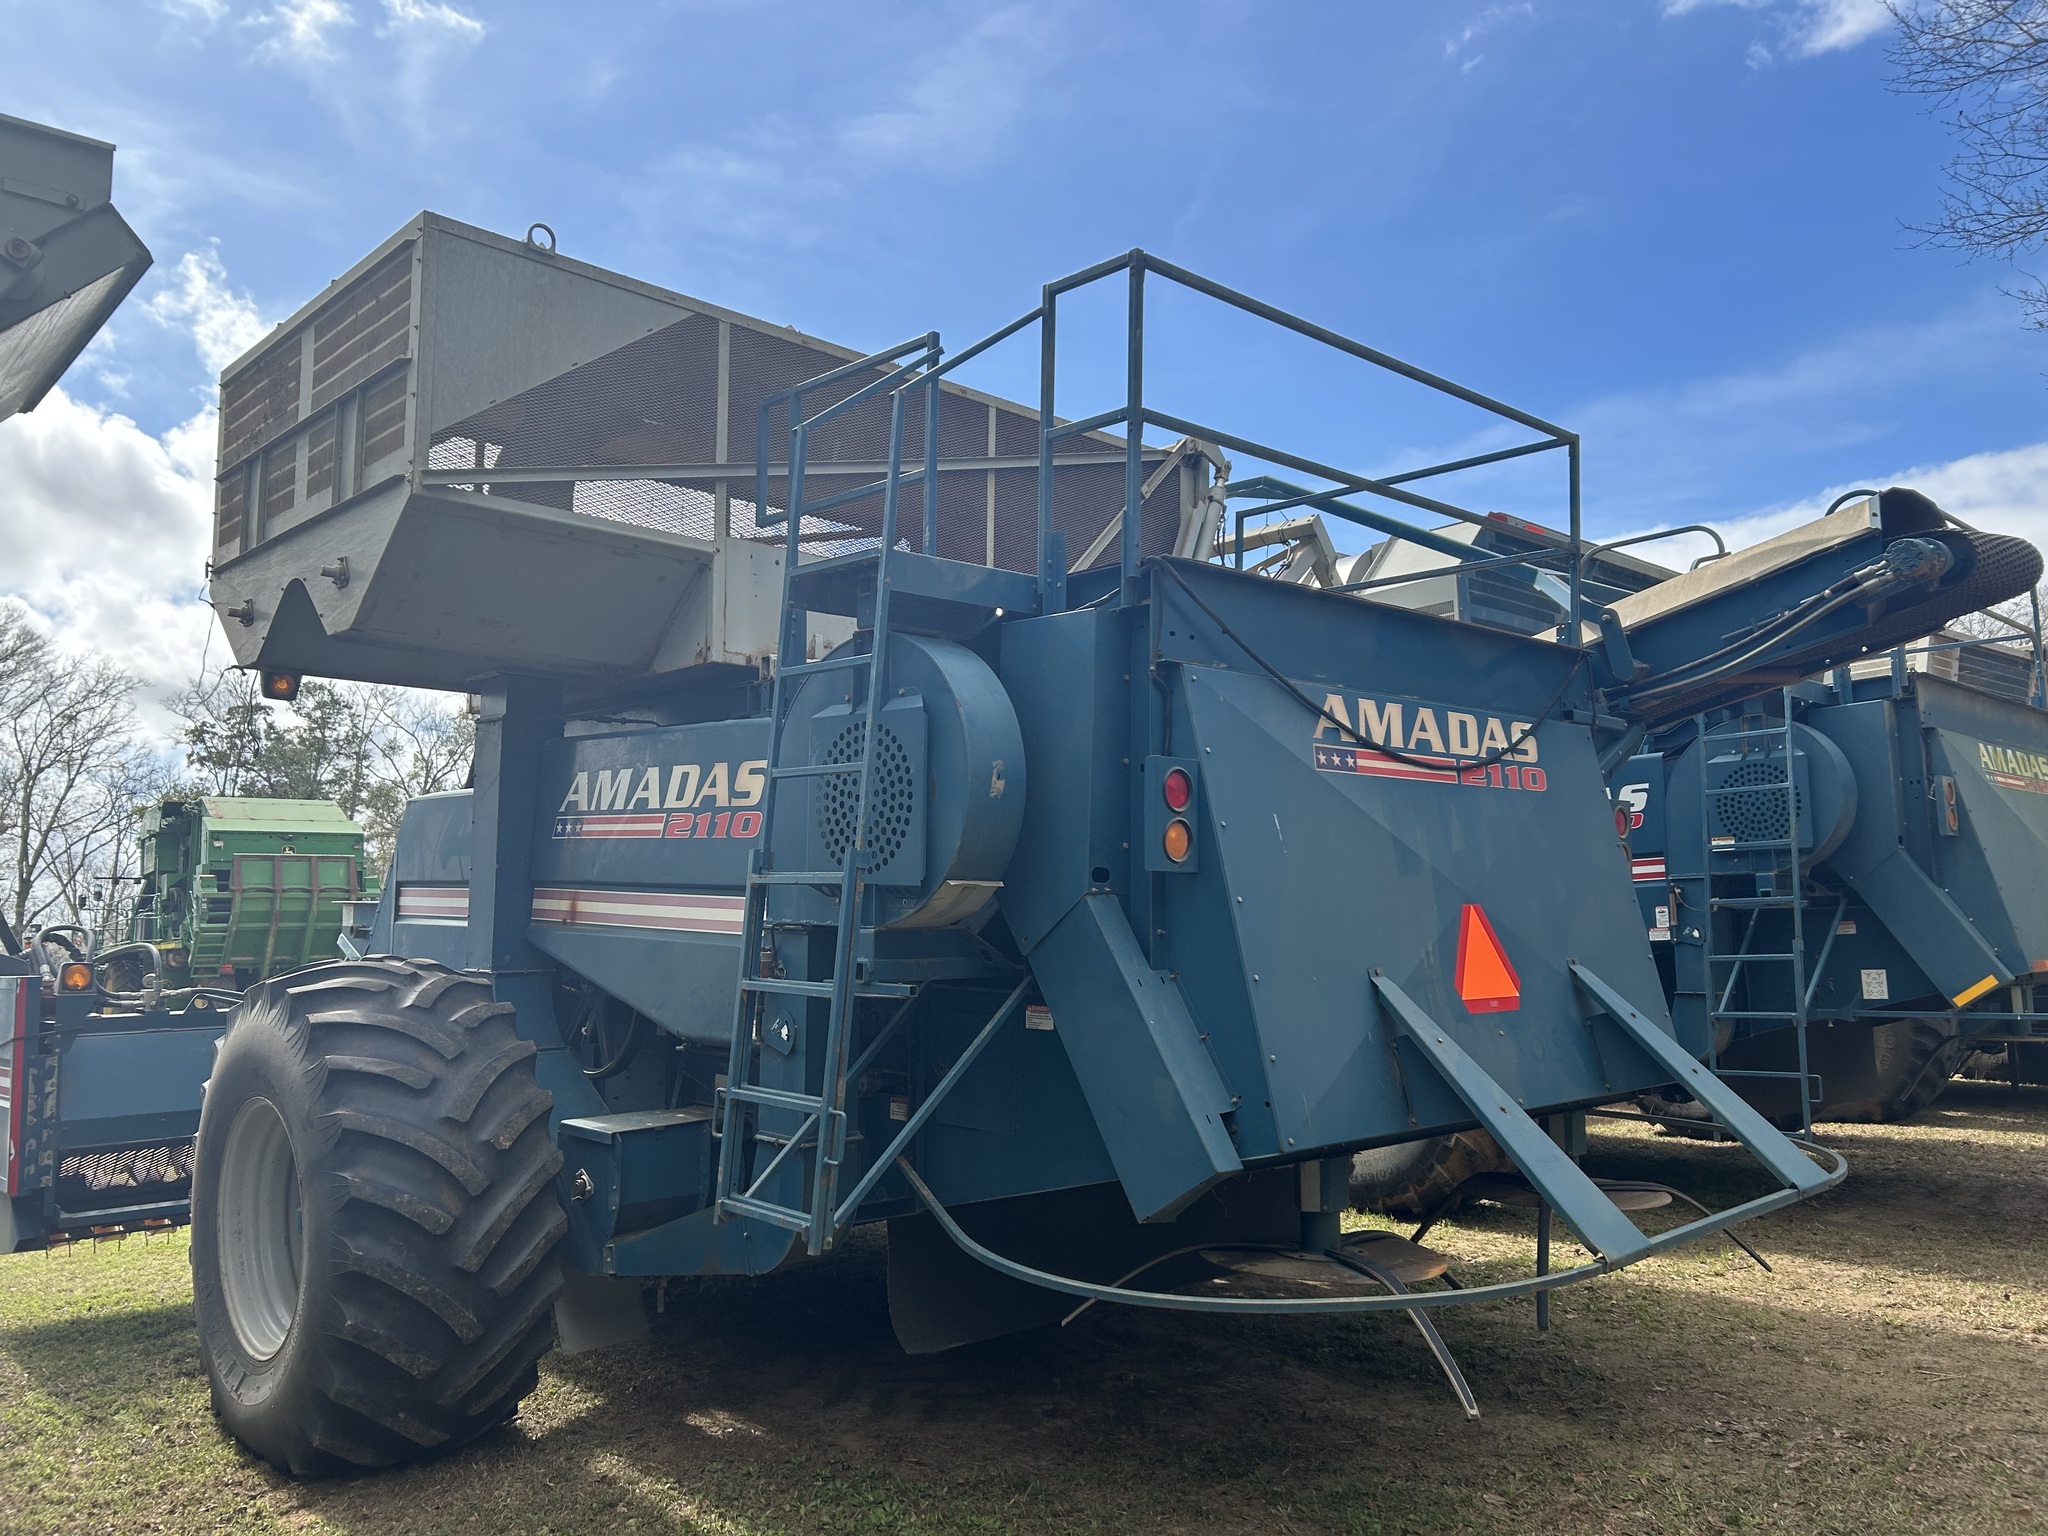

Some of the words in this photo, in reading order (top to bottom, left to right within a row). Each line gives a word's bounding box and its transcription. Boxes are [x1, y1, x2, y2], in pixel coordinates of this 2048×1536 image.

[1313, 693, 1538, 763] AMADAS
[558, 759, 768, 812] AMADAS
[1460, 760, 1547, 791] 2110
[664, 811, 763, 838] 2110
